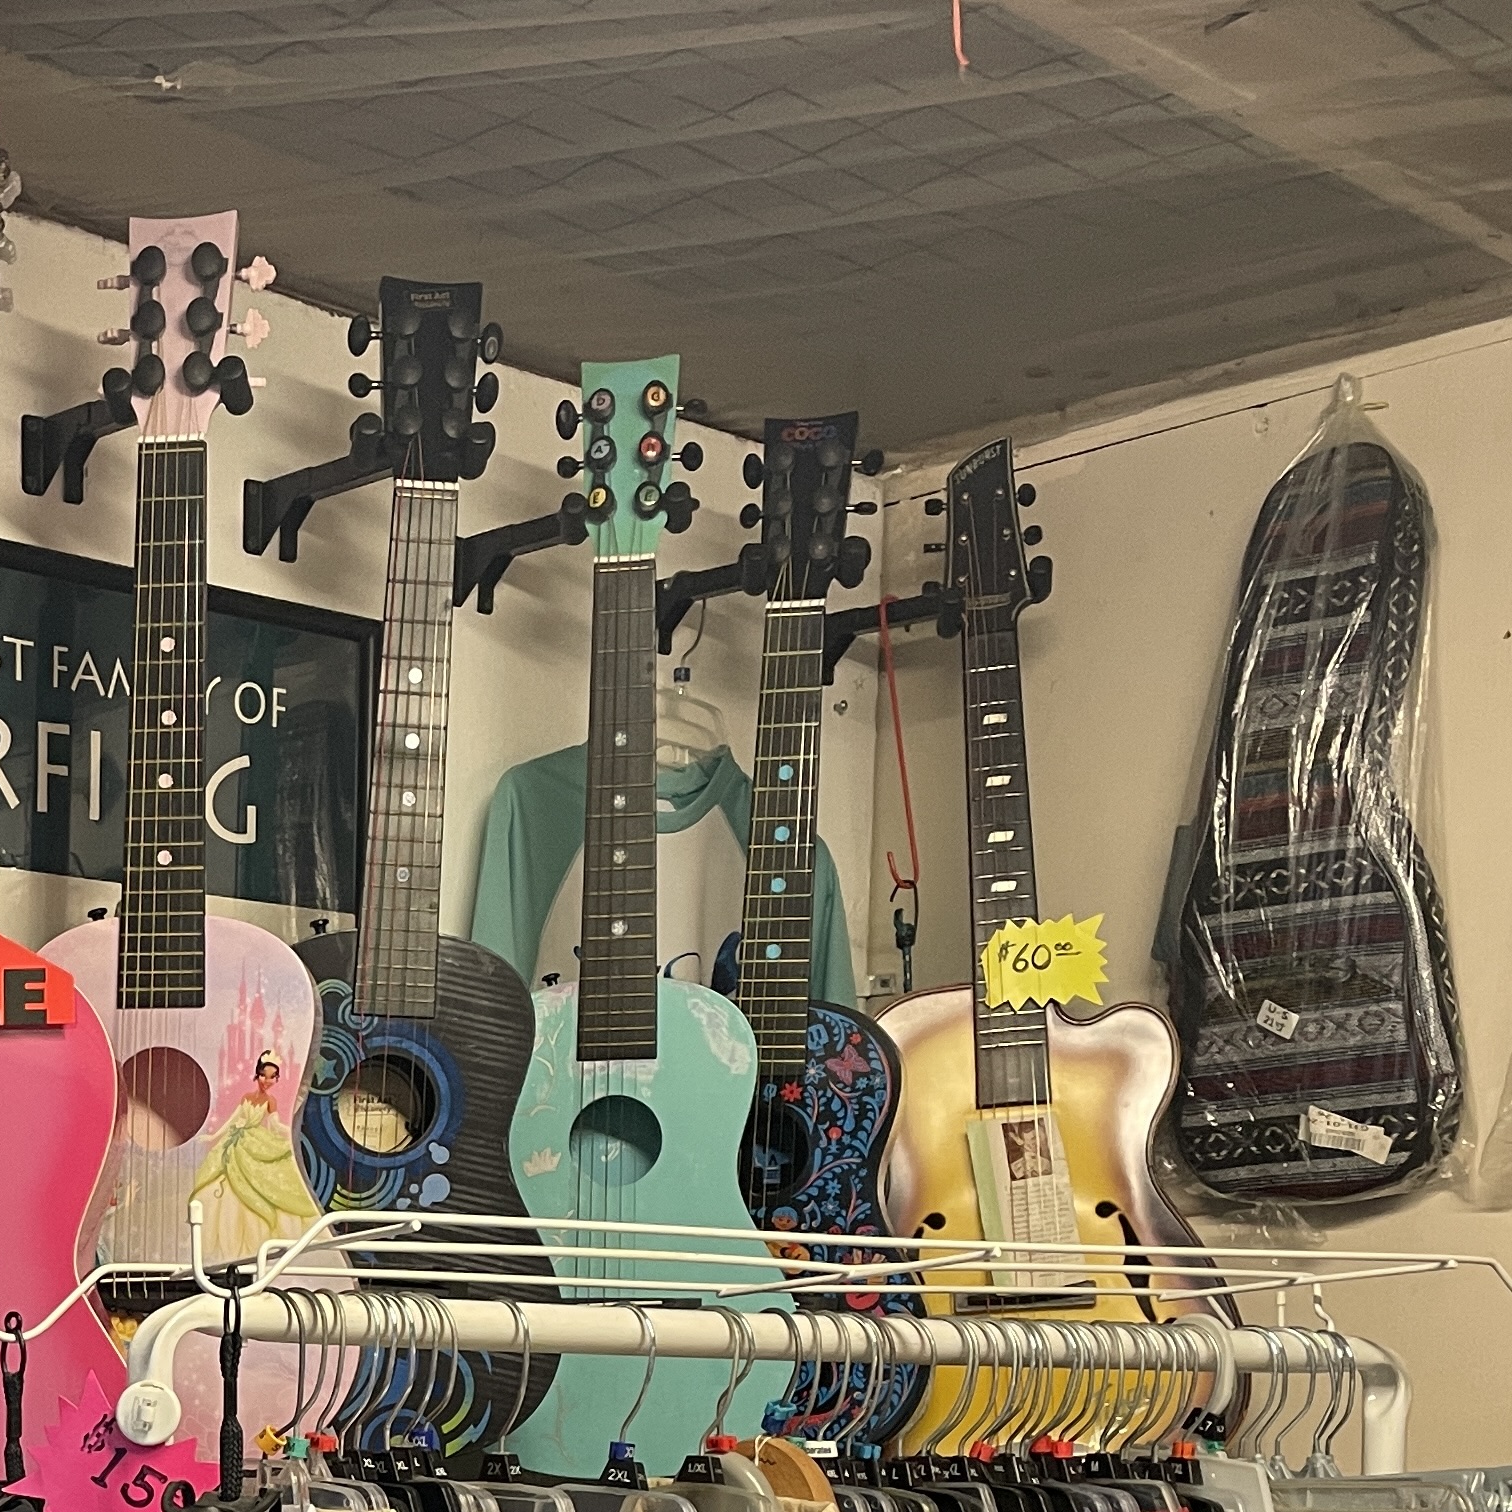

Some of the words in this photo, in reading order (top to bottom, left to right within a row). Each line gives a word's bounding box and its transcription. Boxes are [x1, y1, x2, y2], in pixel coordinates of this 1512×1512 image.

[234, 681, 287, 728] OF
[362, 1457, 376, 1469] XL
[395, 1460, 409, 1471] XL
[487, 1461, 502, 1476] 2X
[688, 1462, 707, 1474] L/XL
[509, 1465, 522, 1475] 2X
[607, 1468, 631, 1483] 2XL
[891, 1467, 899, 1480] L
